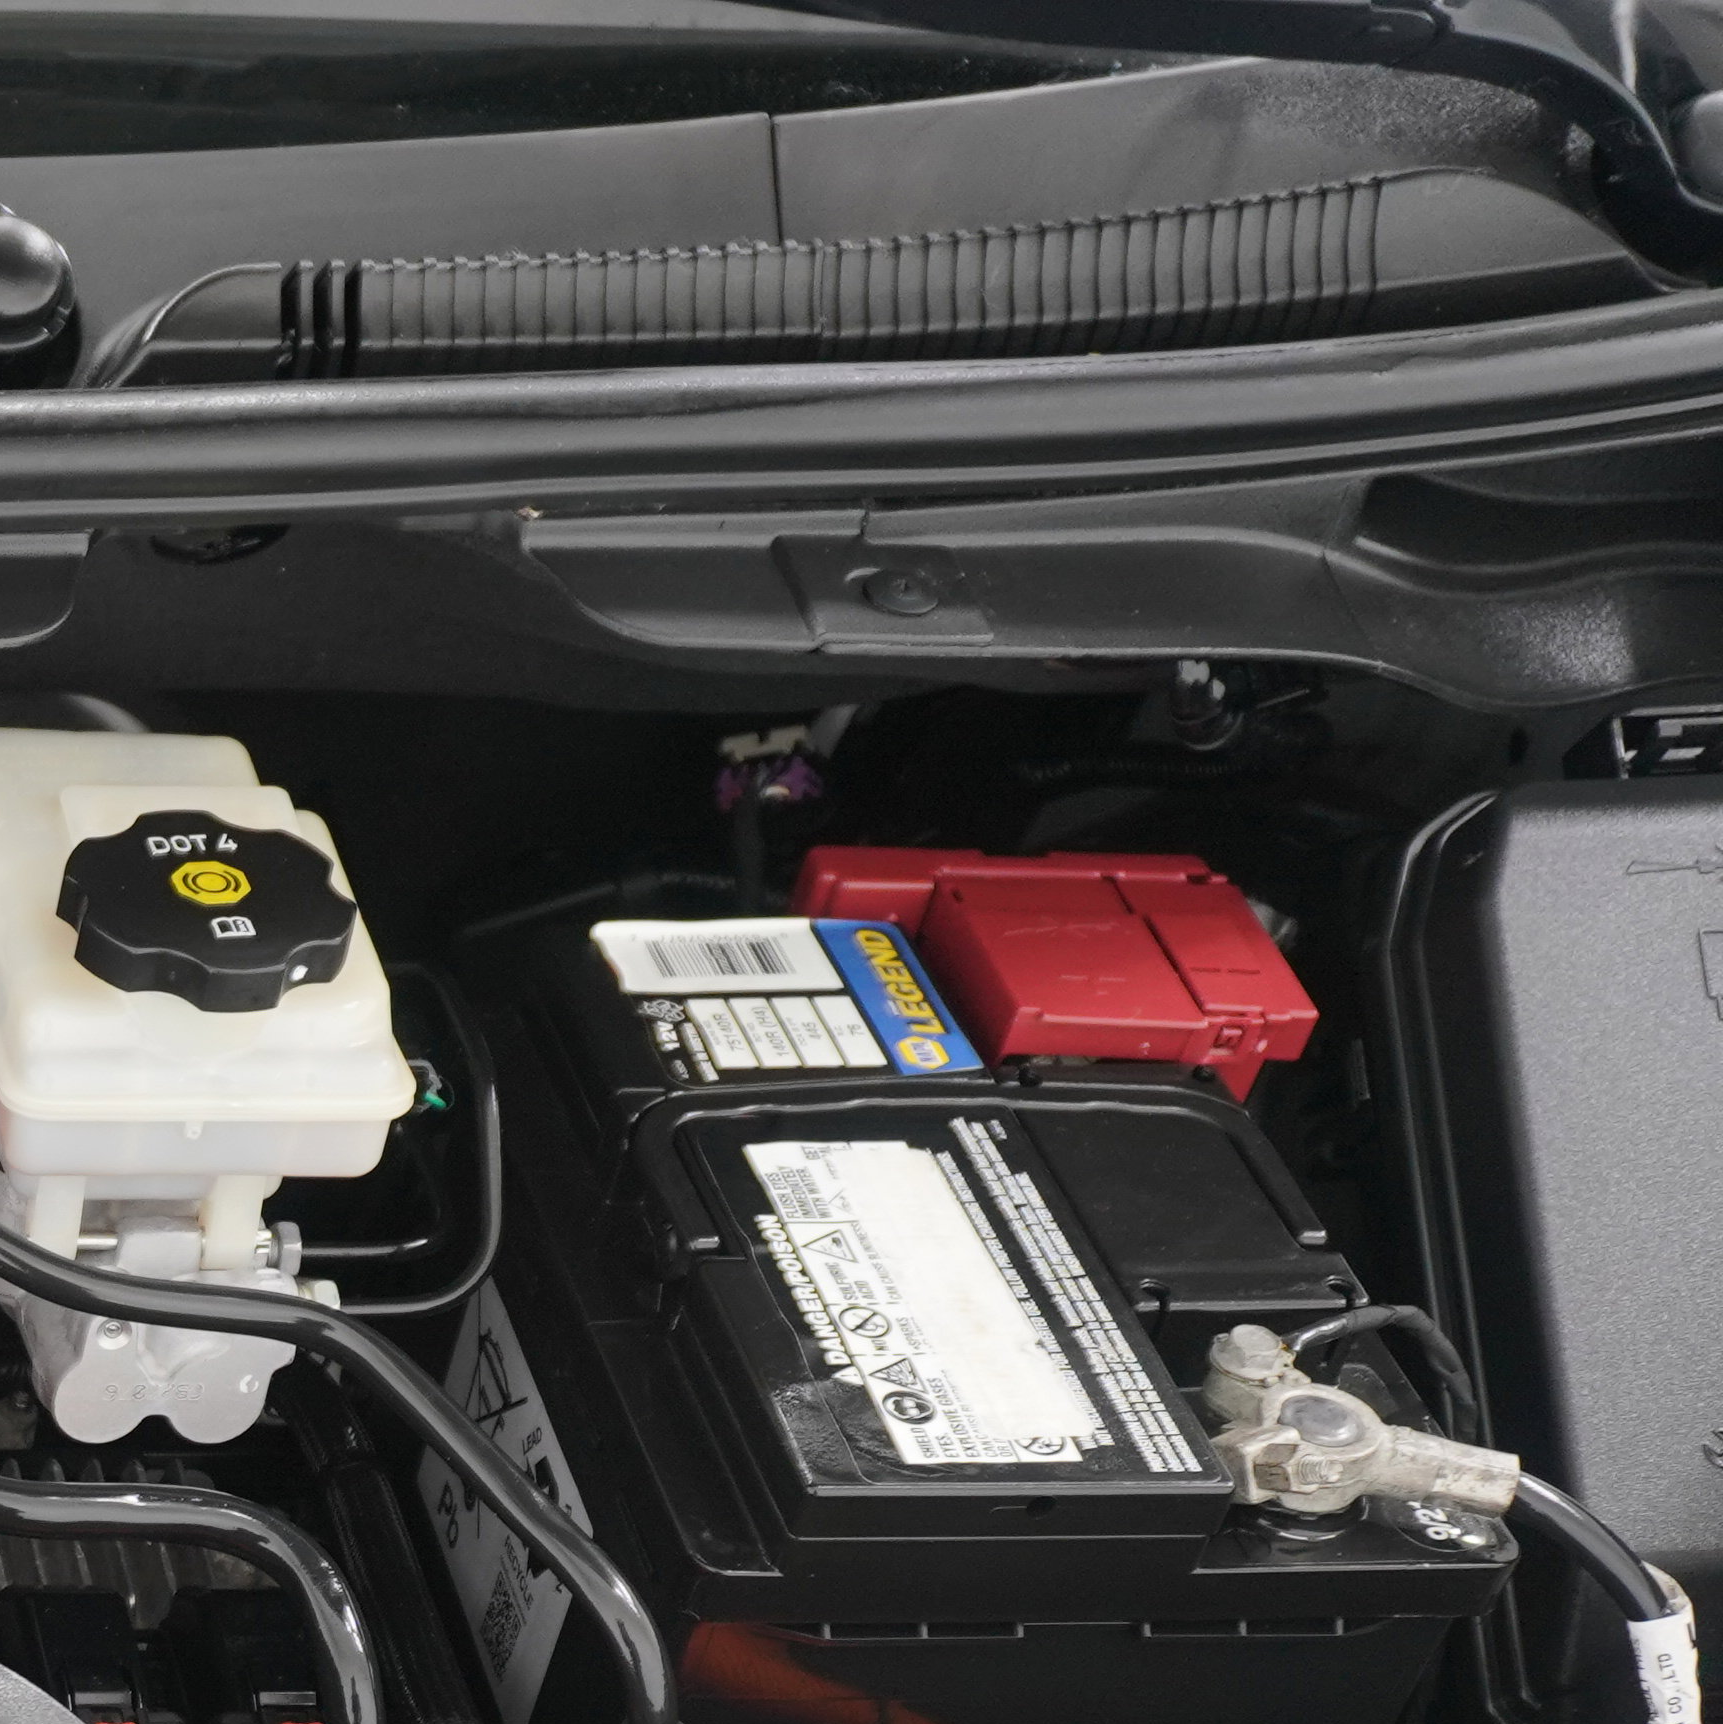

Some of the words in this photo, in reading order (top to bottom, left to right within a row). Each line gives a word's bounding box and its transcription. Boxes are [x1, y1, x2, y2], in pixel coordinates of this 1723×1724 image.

[147, 834, 207, 855] DOT
[217, 833, 238, 851] 4
[854, 928, 948, 1036] LEGEND
[652, 1020, 684, 1049] 12V
[713, 1013, 744, 1051] 75140R
[776, 1193, 801, 1218] FLUSH
[778, 1166, 818, 1218] IMMEDIATELY
[809, 1197, 834, 1218] WITH
[755, 1213, 853, 1366] DANGER/POISON
[824, 1262, 859, 1300] SULFURIC
[853, 1280, 877, 1298] ACID
[870, 1339, 891, 1350] NO
[925, 1377, 955, 1405] GASES
[521, 1426, 544, 1456] LEAD
[908, 1427, 940, 1457] SHIELD
[942, 1408, 981, 1456] EXPLOSIVE
[974, 1440, 998, 1456] CAN
[436, 1484, 461, 1549] Pb
[503, 1534, 534, 1611] RECYCLE
